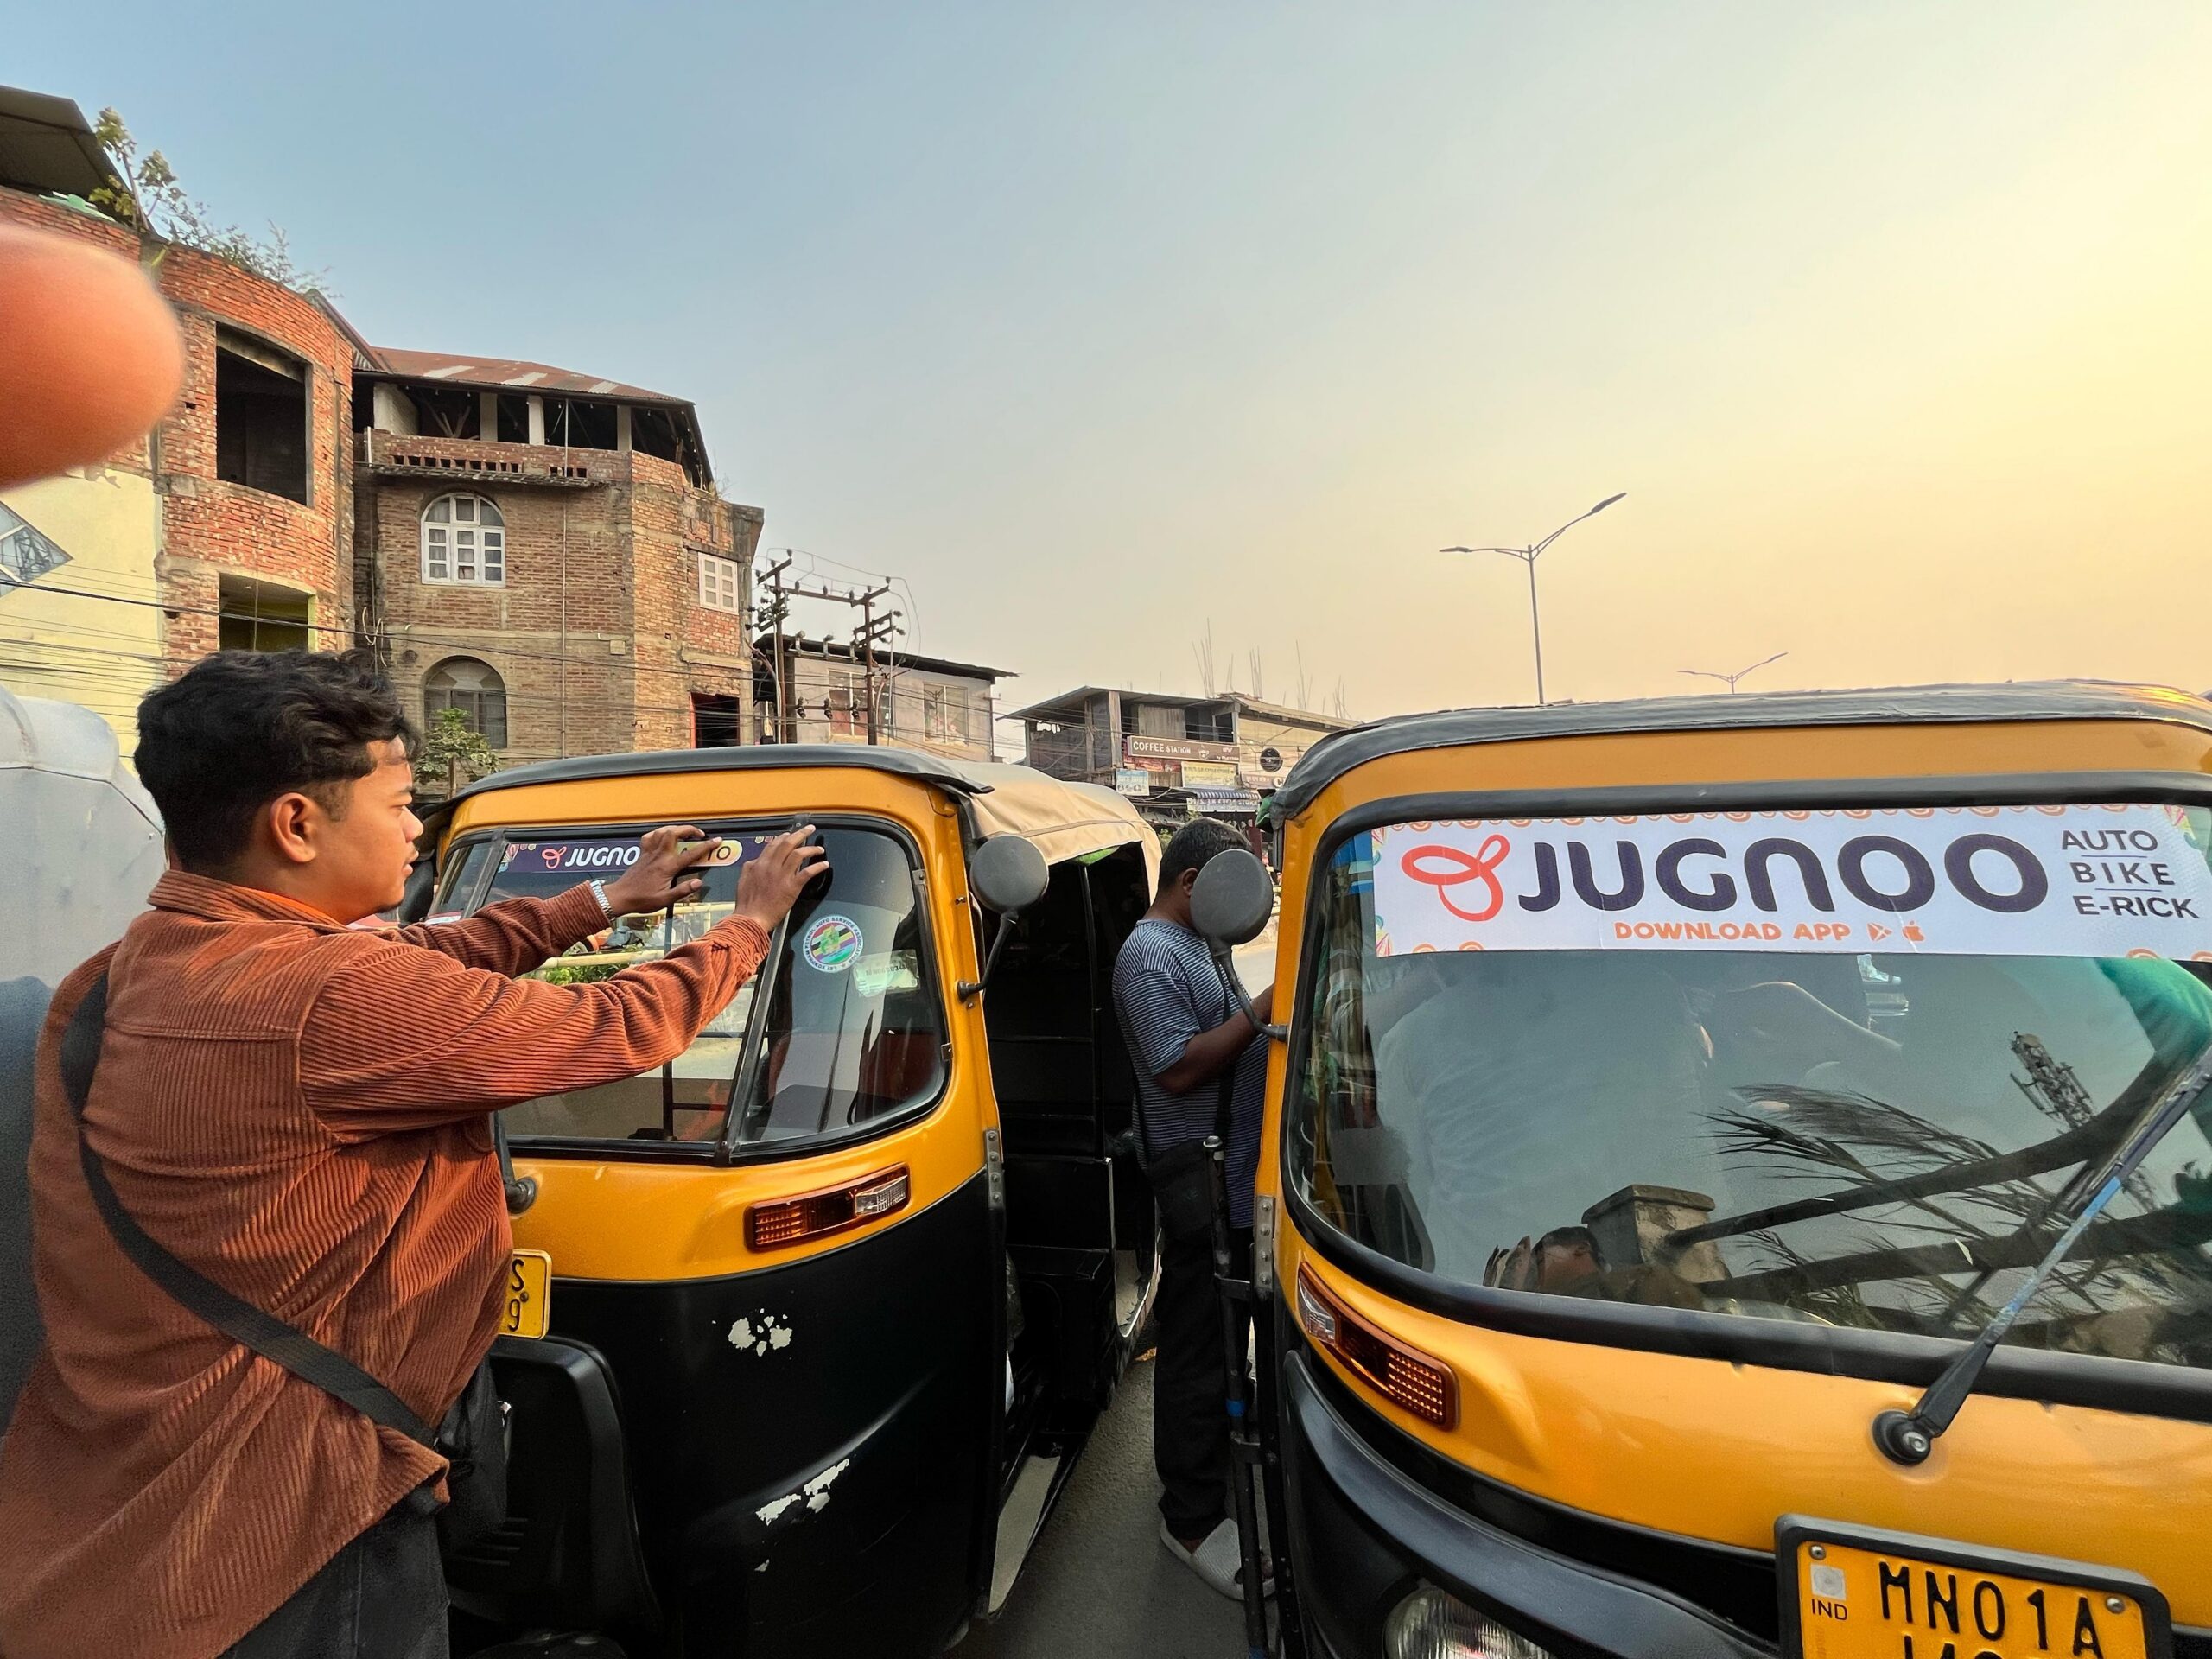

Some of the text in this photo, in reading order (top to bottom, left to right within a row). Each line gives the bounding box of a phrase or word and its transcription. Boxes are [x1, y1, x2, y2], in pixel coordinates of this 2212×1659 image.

[1133, 741, 1165, 753] COFFEE
[1166, 745, 1191, 754] STATION
[2062, 830, 2158, 851] AUTO
[564, 846, 640, 867] JUGNO
[1518, 833, 2048, 912] JUGNOO
[2069, 862, 2175, 885] BIKE
[2072, 895, 2200, 919] E-RICK
[804, 928, 816, 949] PETROL
[815, 918, 830, 929] AUTO
[831, 916, 855, 928] SERVICE
[848, 928, 862, 964] ASSOCIATION
[1614, 922, 1851, 941] DOWNLOAD APP
[1811, 1599, 1848, 1621] IND
[1878, 1560, 2106, 1659] MN01A
